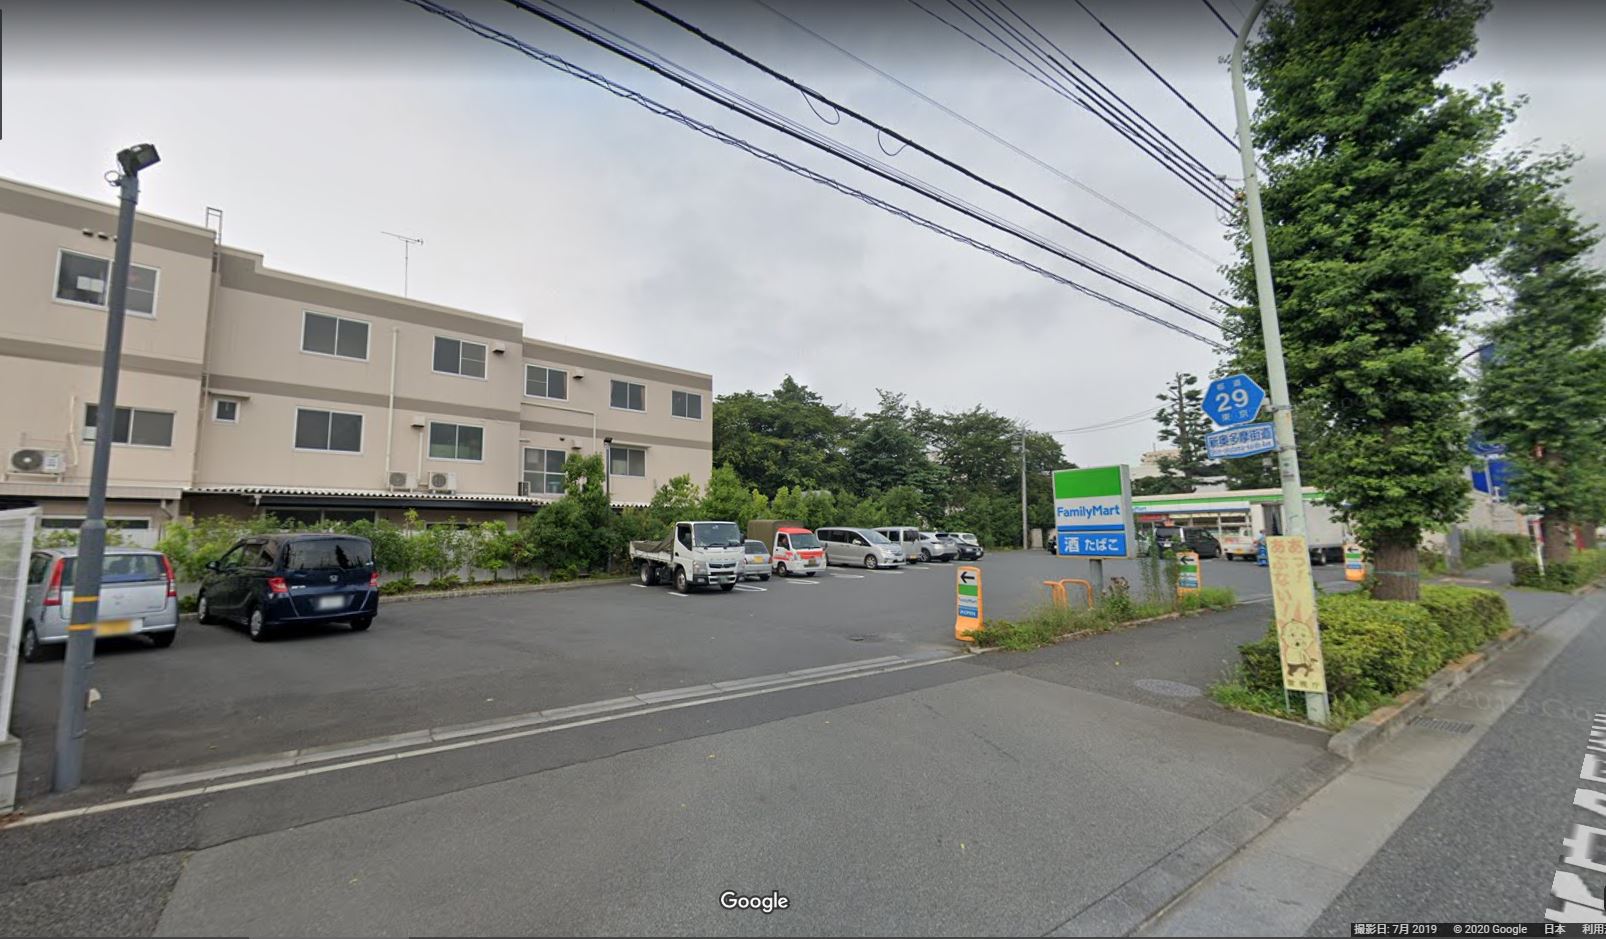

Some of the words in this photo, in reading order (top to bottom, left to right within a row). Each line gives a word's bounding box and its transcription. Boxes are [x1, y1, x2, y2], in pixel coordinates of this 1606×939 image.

[1215, 388, 1249, 413] 29
[1057, 504, 1121, 519] FamilyMart
[1064, 536, 1080, 553] 酒
[1085, 537, 1119, 551] たばこ
